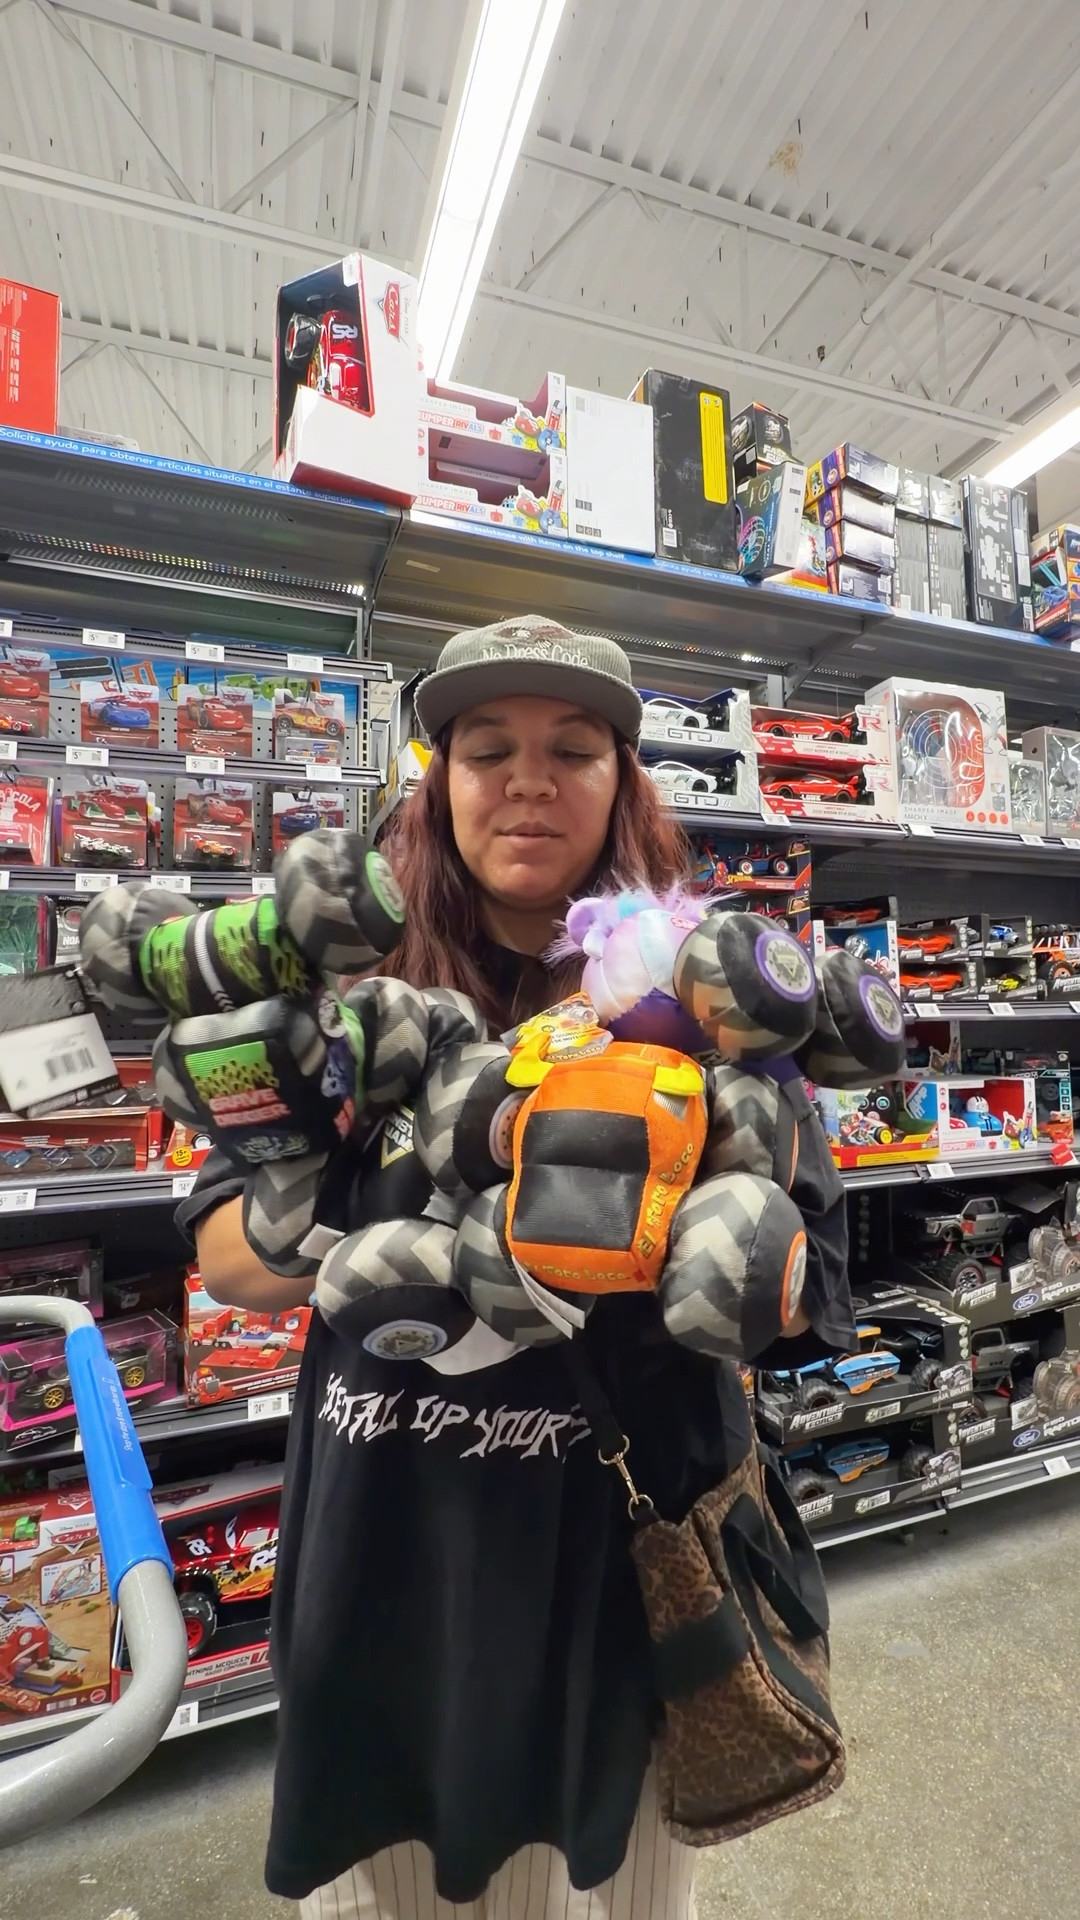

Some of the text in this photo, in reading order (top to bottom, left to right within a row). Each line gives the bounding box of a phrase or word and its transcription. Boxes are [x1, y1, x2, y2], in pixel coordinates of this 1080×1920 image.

[387, 285, 399, 333] Cars
[455, 420, 484, 433] RIVALS
[0, 428, 41, 444] Solicita
[44, 439, 78, 451] ayuda
[82, 446, 107, 457] para
[110, 451, 154, 464] obtener
[205, 467, 246, 483] situados
[249, 478, 261, 487] en
[264, 480, 273, 489] el
[275, 483, 312, 496] estante
[456, 503, 484, 515] RIVALS
[475, 525, 516, 539] assistance
[519, 533, 537, 544] with
[539, 538, 562, 549] items
[563, 542, 574, 550] on
[575, 544, 589, 553] the
[590, 548, 604, 559] top
[605, 550, 627, 561] shelf.
[482, 643, 589, 666] No Dress Code
[861, 716, 883, 731] R
[904, 806, 957, 815] SHARPER IMAGE
[904, 813, 922, 821] MACH
[659, 1142, 695, 1185] Loco
[645, 1184, 669, 1229] Toro
[635, 1229, 657, 1259] El
[1041, 1283, 1080, 1301] RAPTO
[1017, 1296, 1035, 1309] Ford
[932, 1384, 971, 1403] BAJA BRUTE
[318, 1372, 405, 1444] METAL
[410, 1395, 471, 1443] UP
[789, 1403, 845, 1430] ADVENTURE
[804, 1412, 844, 1432] FORCE
[1043, 1414, 1080, 1437] RAPTO
[1018, 1431, 1036, 1446] Ford
[54, 1530, 92, 1544] Cars
[215, 1654, 251, 1670] MCQUEEN
